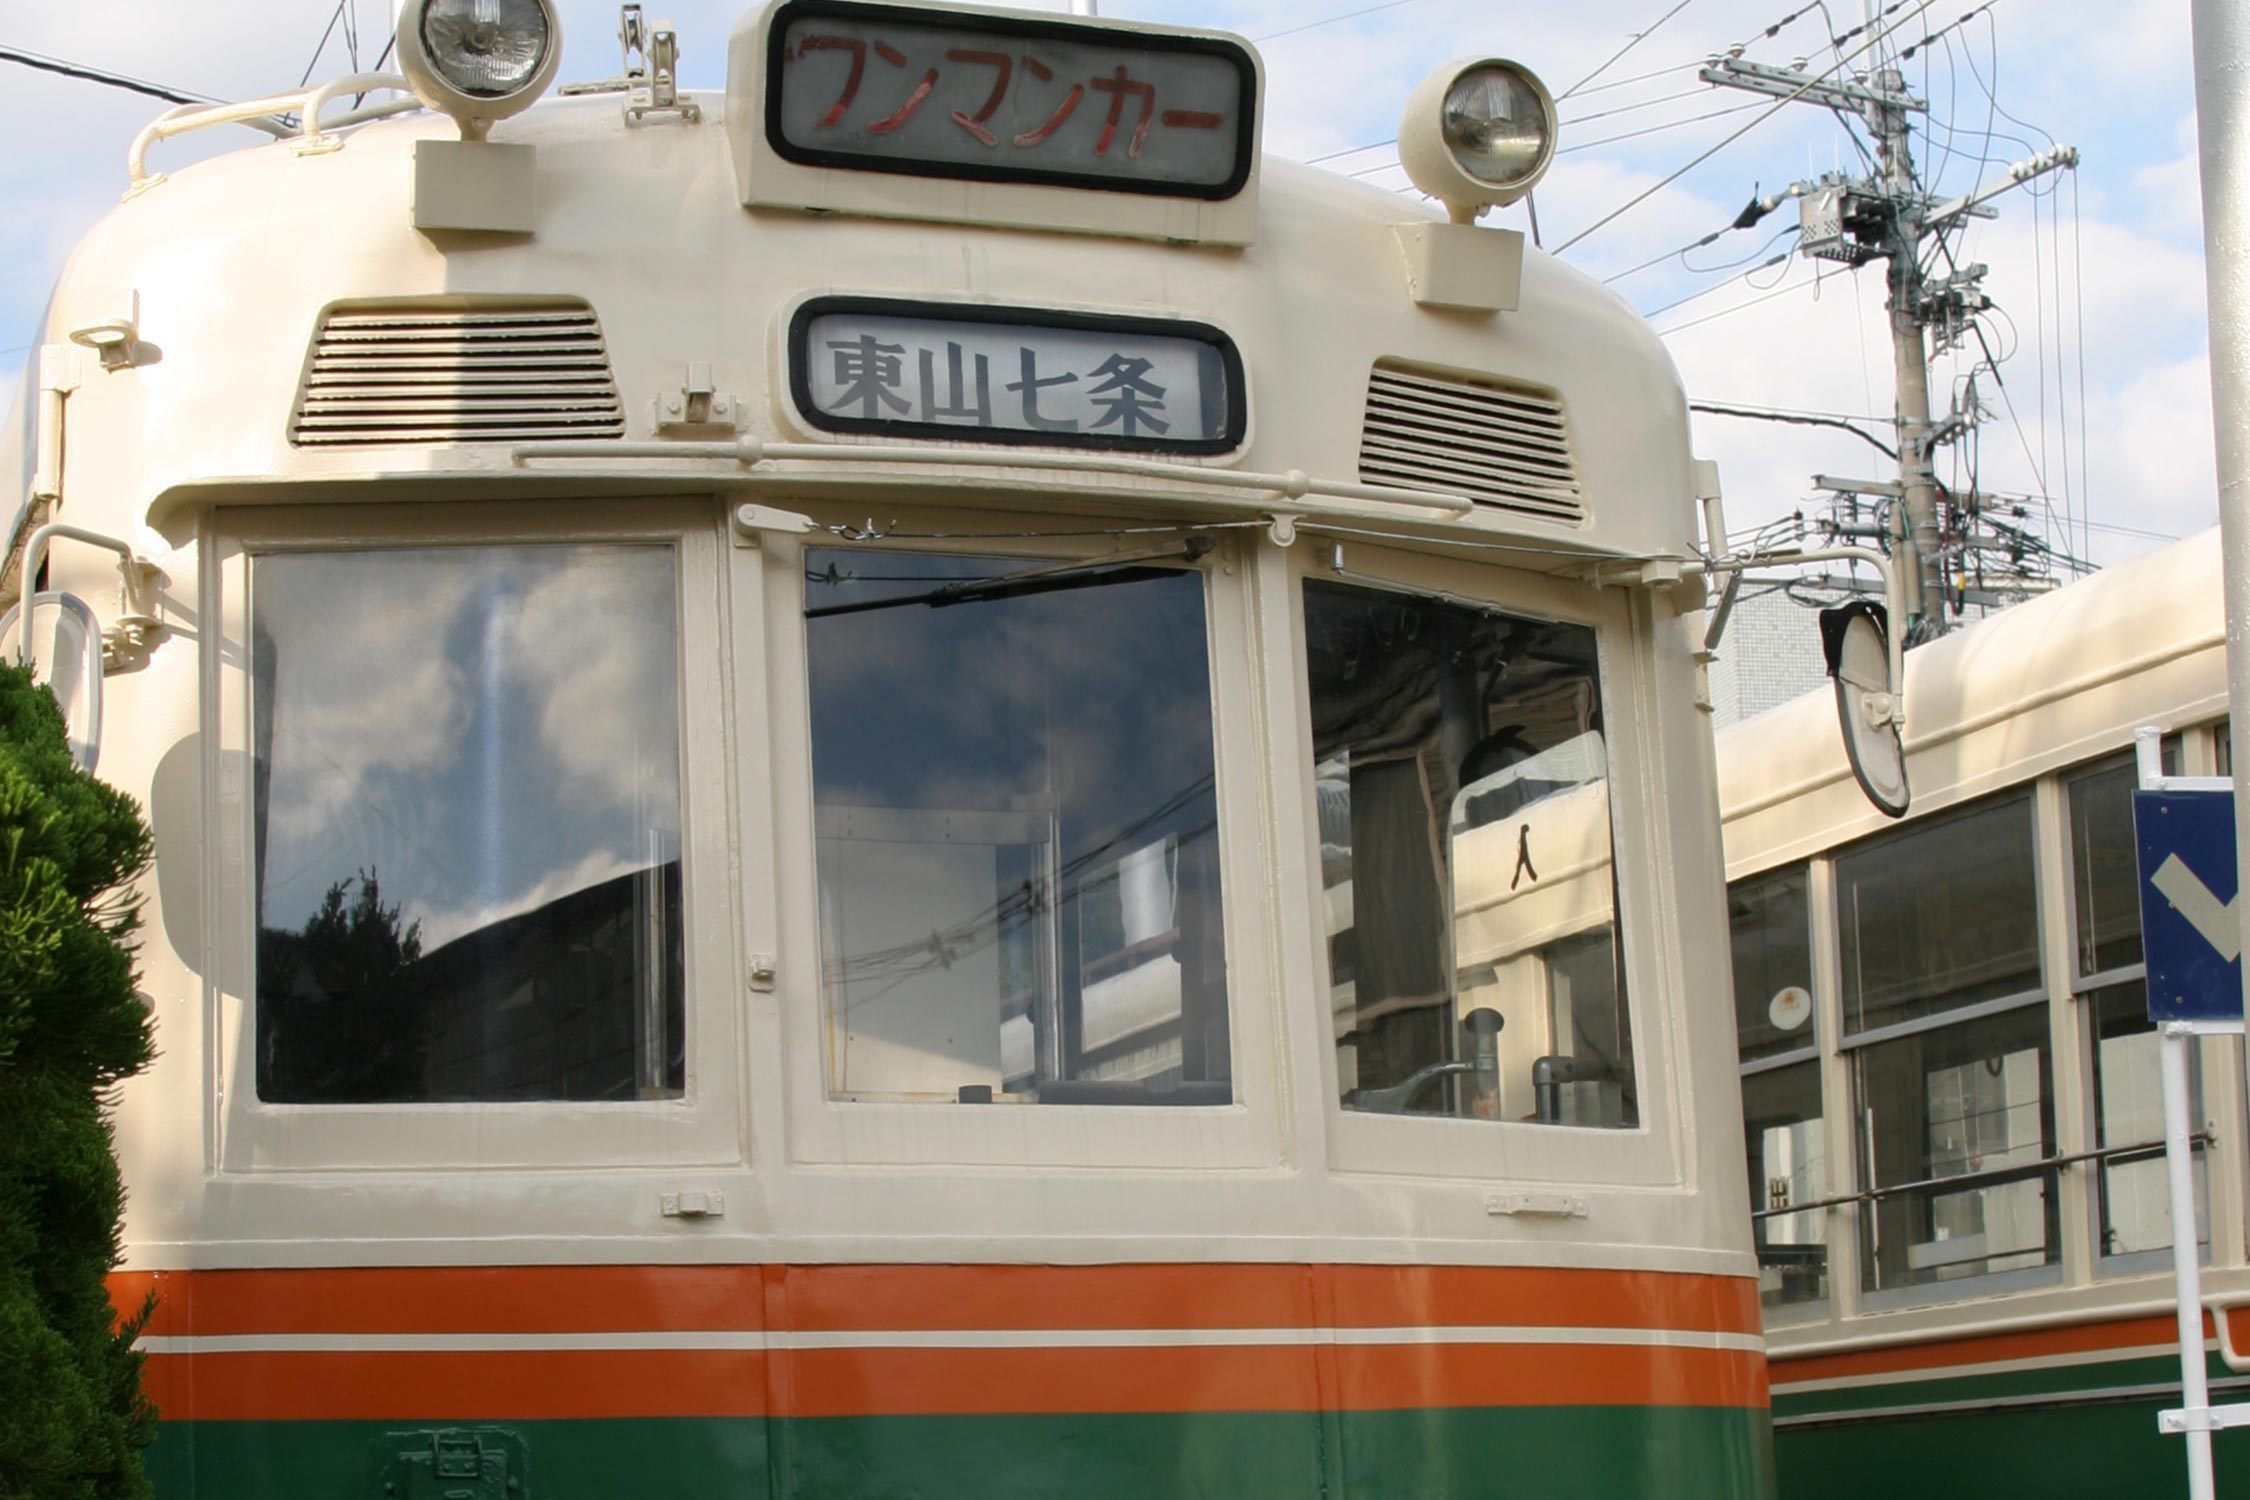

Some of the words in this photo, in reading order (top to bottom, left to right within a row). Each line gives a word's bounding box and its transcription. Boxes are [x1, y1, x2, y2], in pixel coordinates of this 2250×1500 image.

[785, 33, 1224, 158] ワンマンカー
[825, 334, 1171, 437] 東山七条
